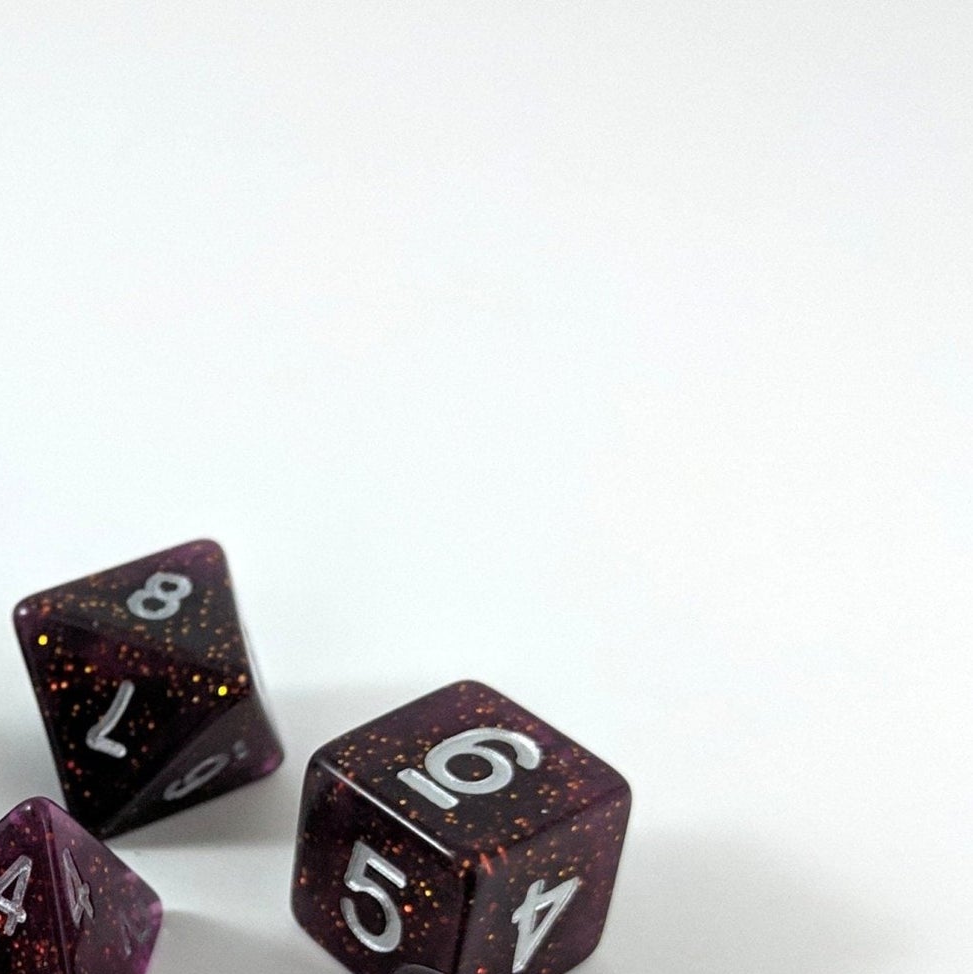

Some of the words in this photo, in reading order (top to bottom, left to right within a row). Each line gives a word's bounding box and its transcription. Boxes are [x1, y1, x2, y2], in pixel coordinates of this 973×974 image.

[126, 571, 193, 621] 8
[85, 679, 135, 759] 7
[62, 847, 95, 928] 4
[339, 840, 408, 953] 5
[511, 876, 582, 974] 4
